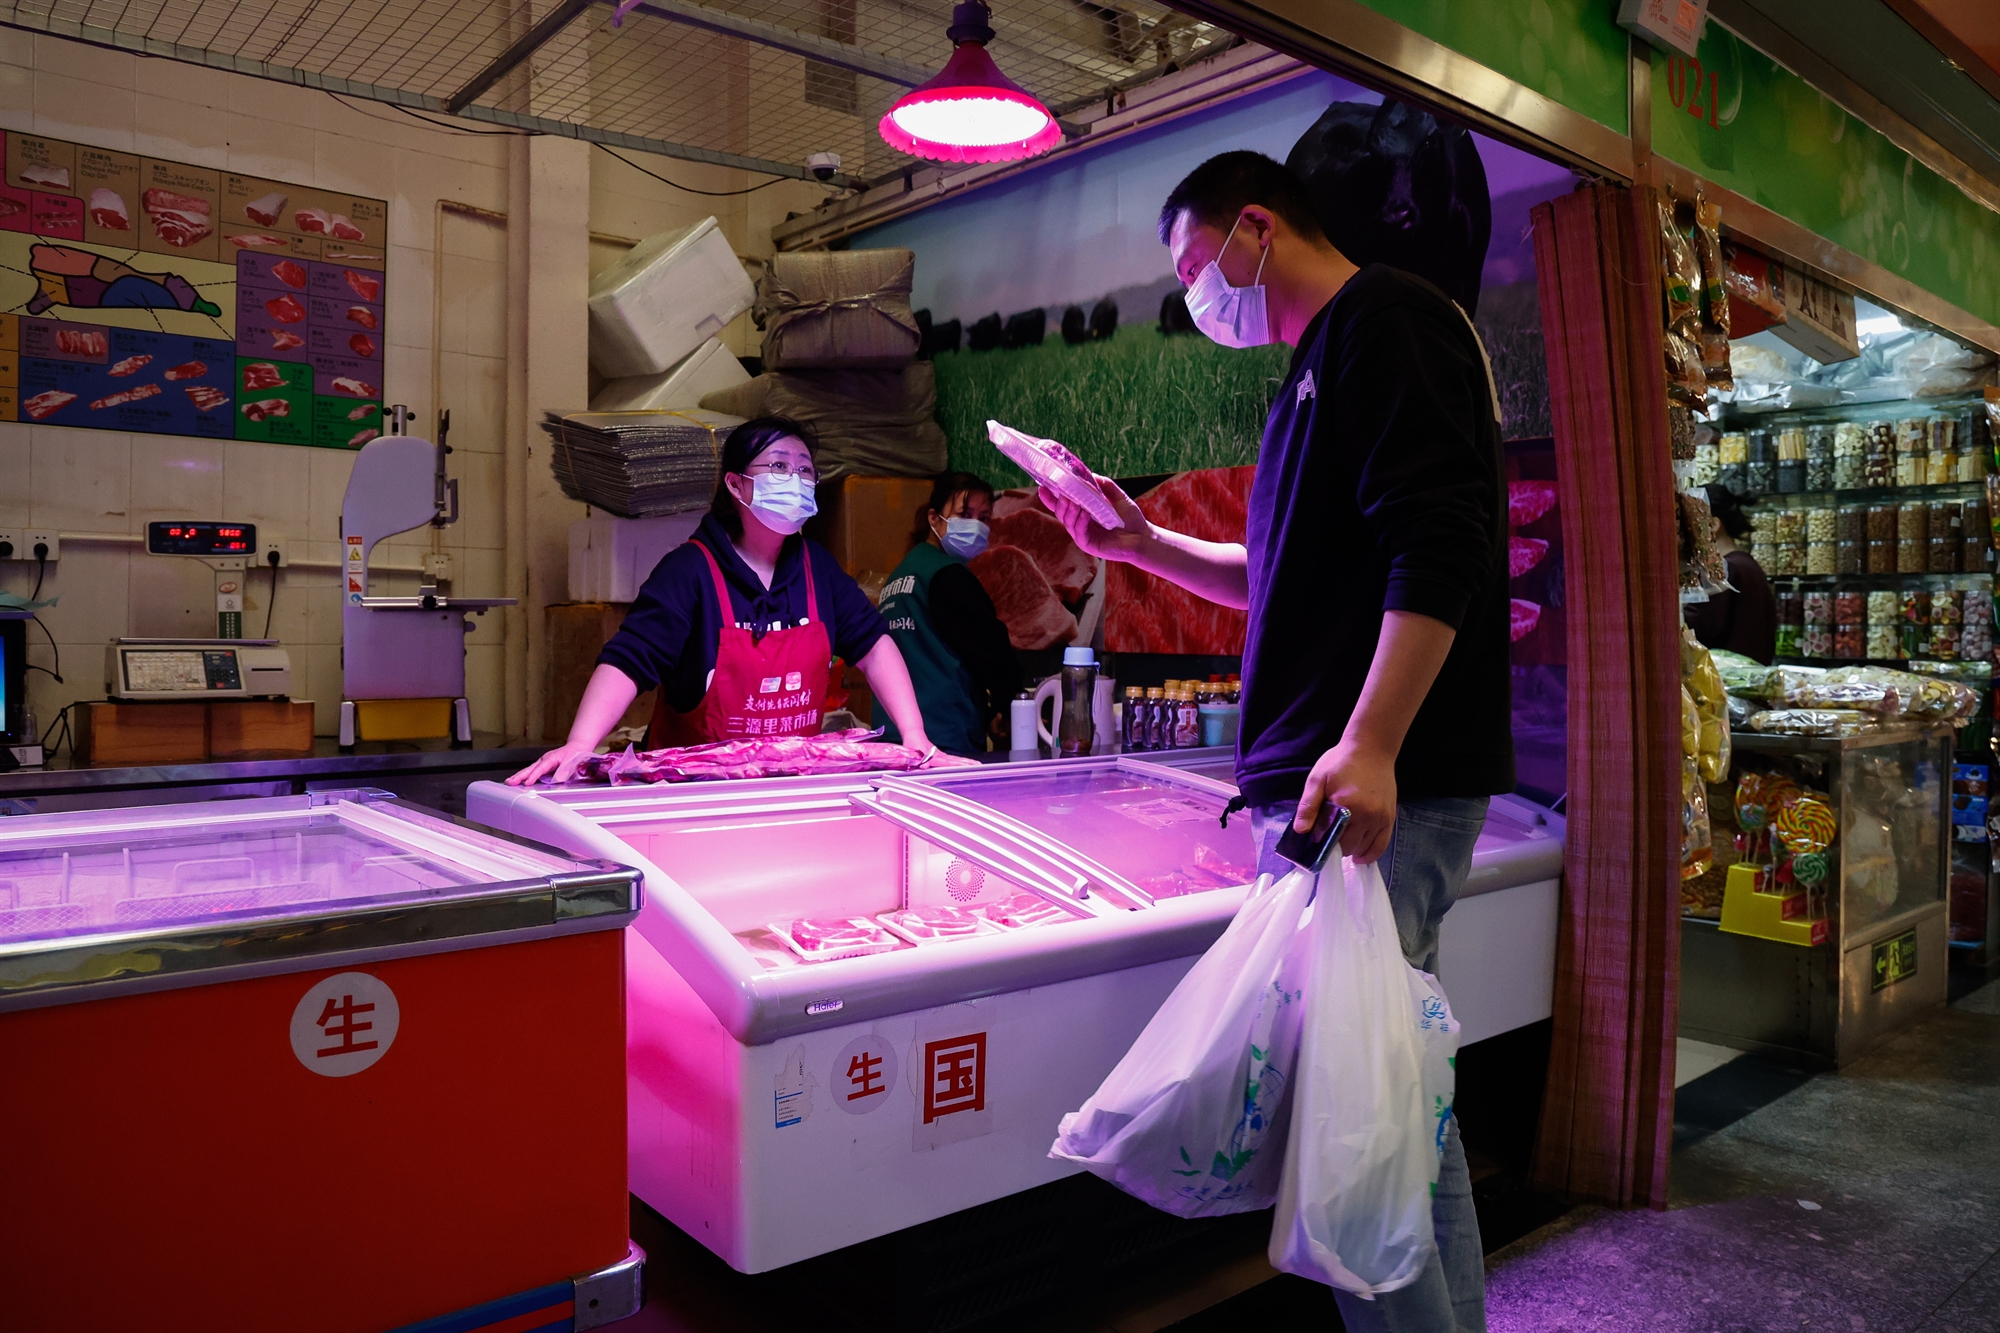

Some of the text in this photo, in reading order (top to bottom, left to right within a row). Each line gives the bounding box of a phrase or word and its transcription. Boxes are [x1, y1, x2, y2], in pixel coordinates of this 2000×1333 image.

[1668, 56, 1721, 131] 021
[726, 708, 818, 735] 三源里菜市场
[316, 994, 379, 1058] 生
[814, 1001, 840, 1011] Haier
[846, 1051, 886, 1102] 生
[923, 1031, 987, 1125] 国
